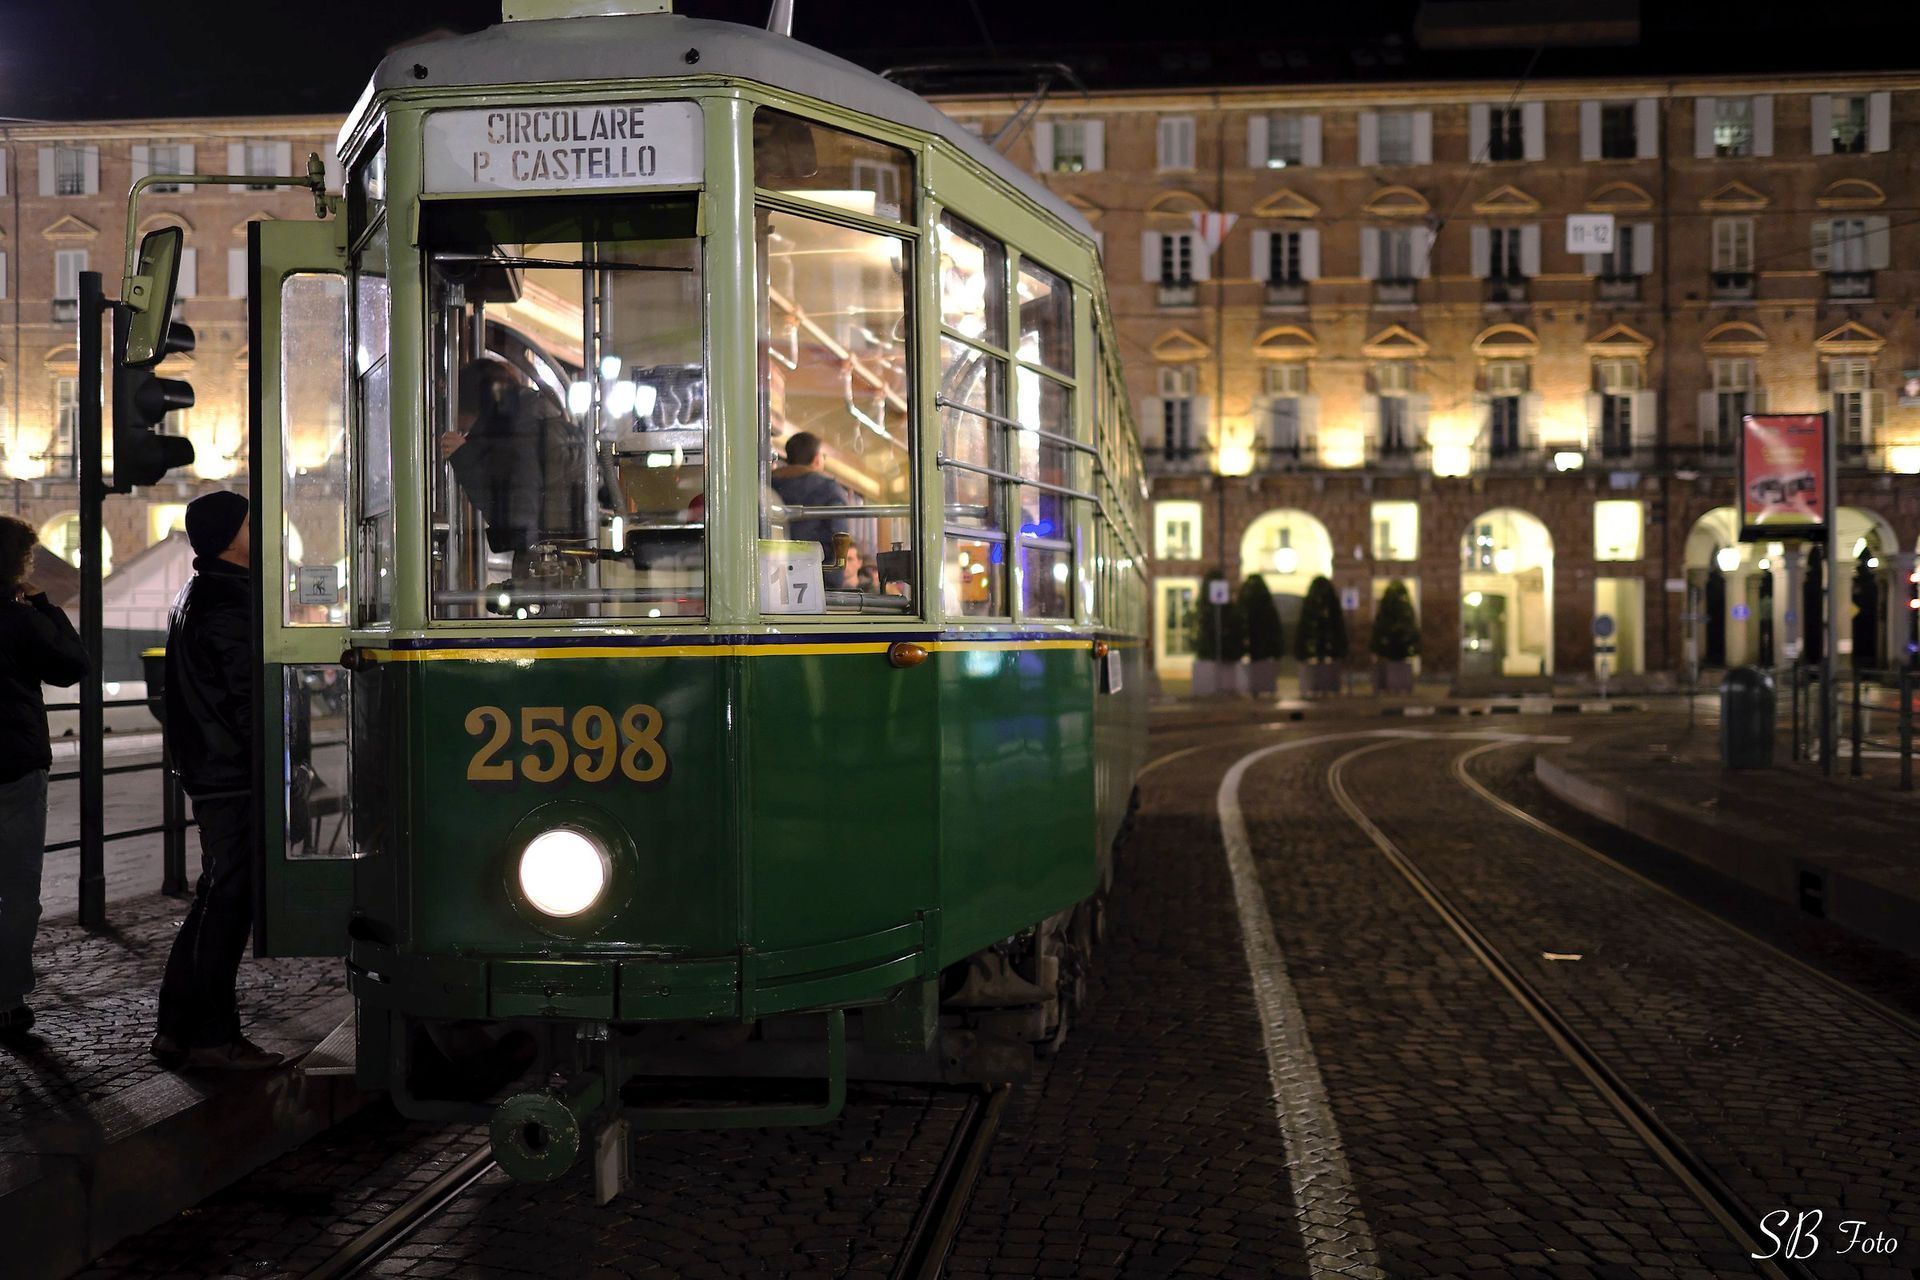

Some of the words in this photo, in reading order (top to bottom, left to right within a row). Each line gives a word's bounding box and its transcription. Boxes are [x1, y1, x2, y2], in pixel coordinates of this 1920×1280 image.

[487, 107, 645, 145] CIRCOLARE
[472, 150, 496, 183] P.
[511, 145, 656, 182] CASTELLO
[464, 703, 668, 783] 2598
